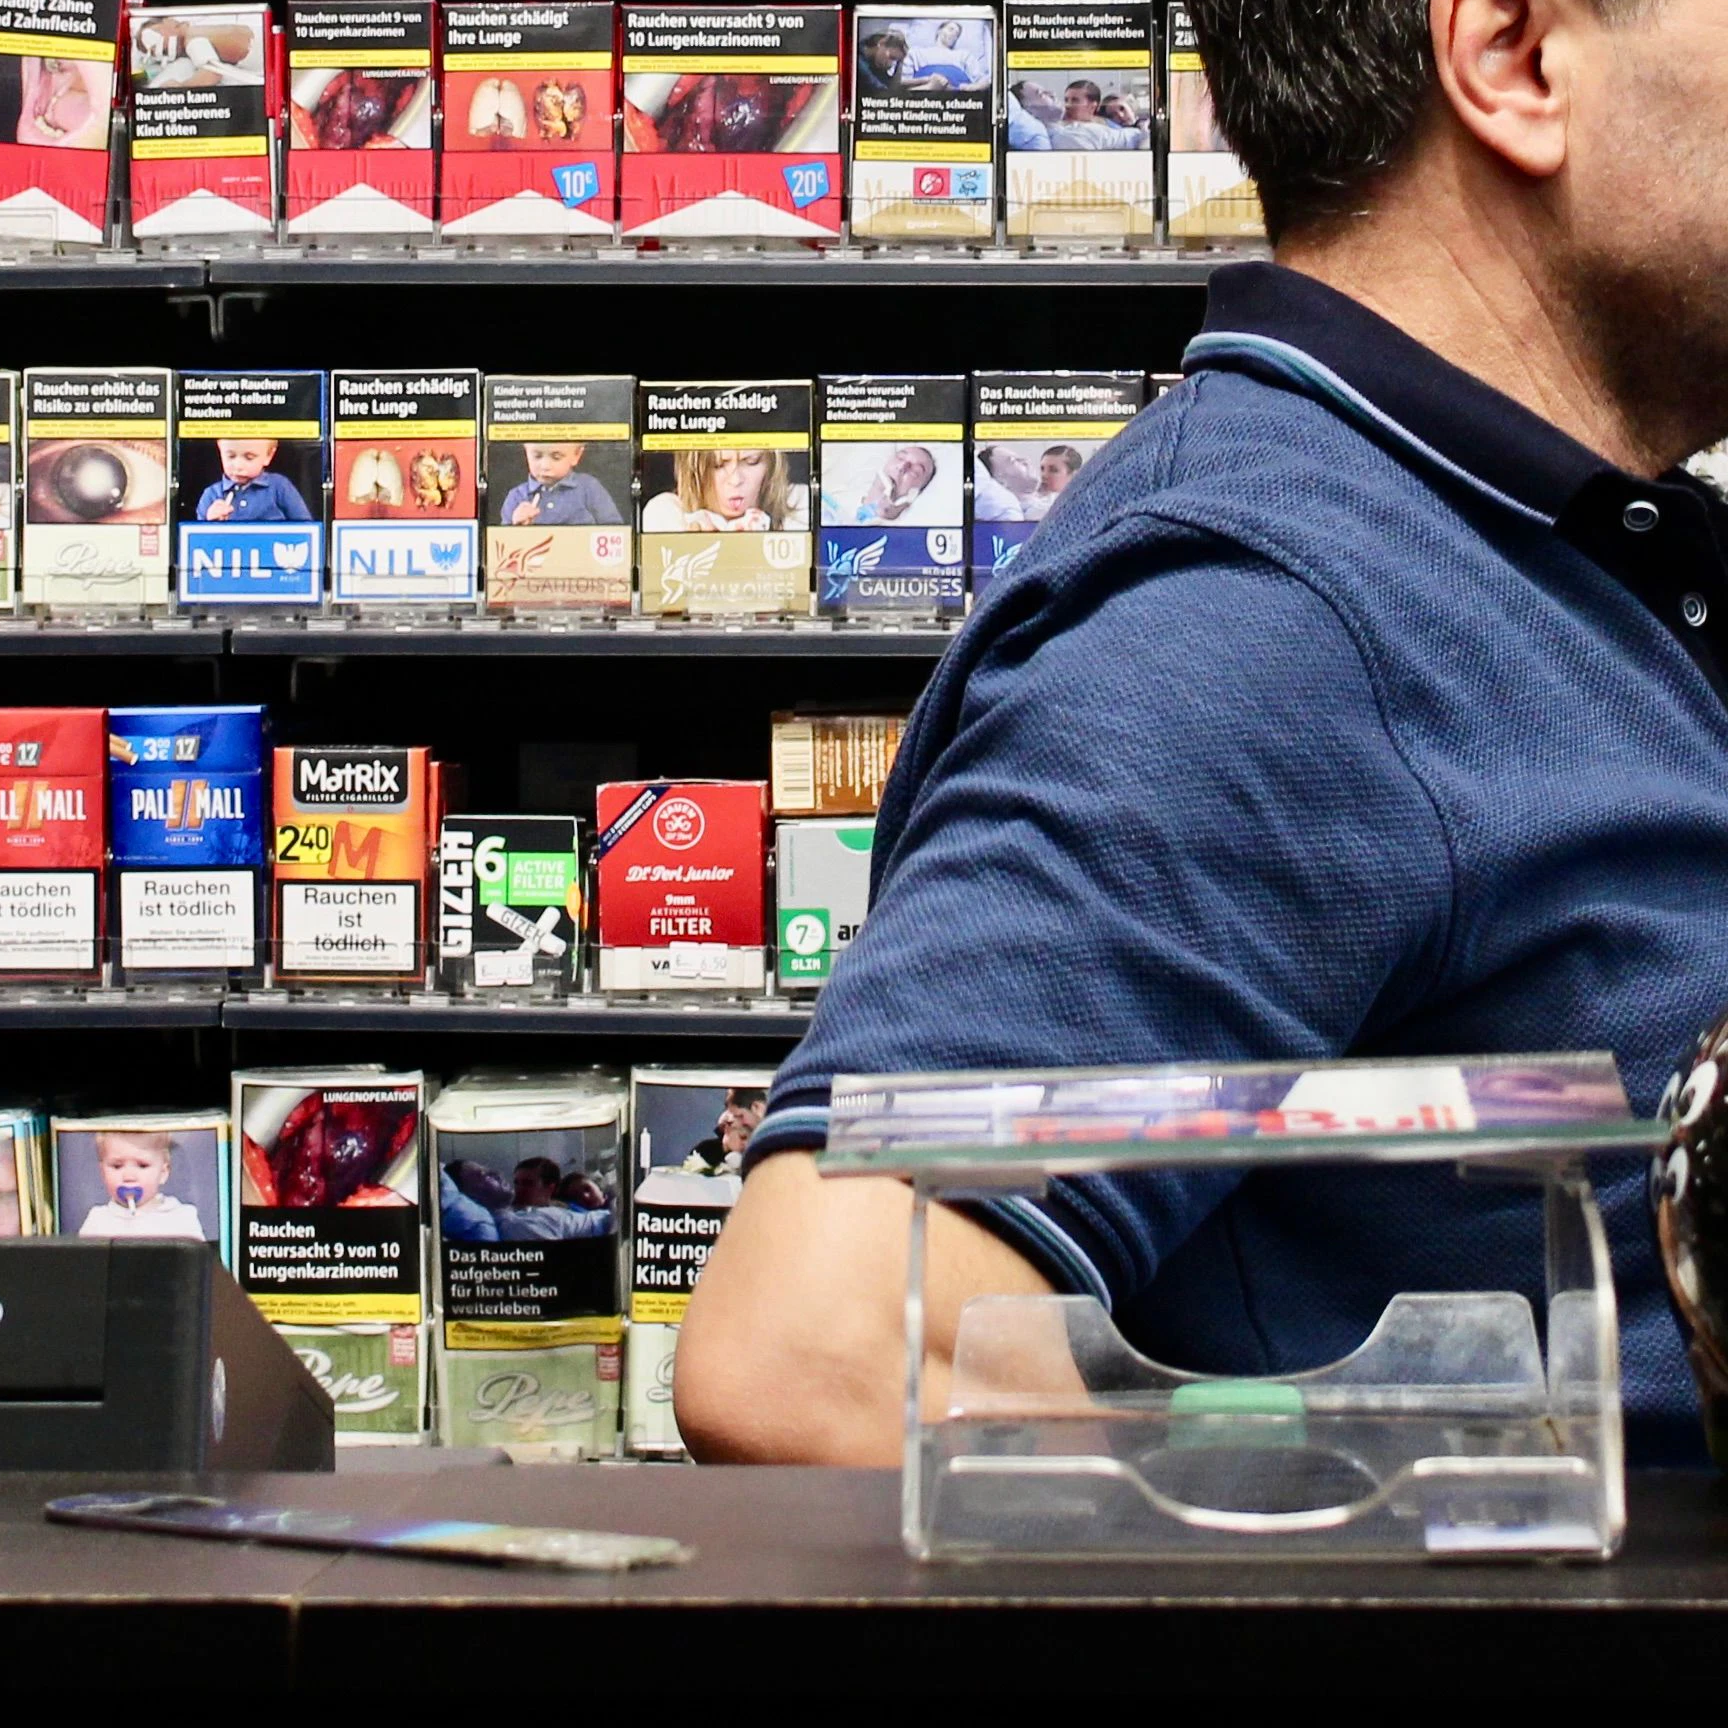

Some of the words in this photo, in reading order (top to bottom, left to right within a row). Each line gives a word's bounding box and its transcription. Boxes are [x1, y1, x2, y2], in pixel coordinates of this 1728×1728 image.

[628, 13, 686, 30] Rauchen
[691, 14, 761, 30] verursacht
[766, 14, 775, 30] 9
[779, 17, 804, 30] von
[628, 31, 645, 47] 10
[648, 31, 781, 50] Lungenkarzinomen
[350, 548, 428, 577] NIL
[858, 576, 964, 598] GAULOISES
[37, 789, 86, 820] MALL
[306, 794, 336, 802] FILTER
[340, 794, 395, 803] CIGARILLOS
[514, 859, 566, 873] ACTIVE
[513, 873, 566, 889] FILTER
[304, 888, 397, 905] Rauchen
[440, 831, 473, 957] GIZEH
[664, 894, 695, 906] 9mm
[9, 900, 76, 919] tödlich
[338, 911, 363, 927] ist
[649, 917, 712, 936] FILTER
[314, 931, 386, 952] tödlich
[323, 1092, 416, 1103] LUNGENOPERATION
[249, 1222, 315, 1239] Rauchen
[249, 1243, 331, 1260] verursacht
[334, 1243, 344, 1259] 9
[348, 1244, 377, 1259] von
[381, 1243, 400, 1259] 10
[249, 1262, 399, 1281] Lungenkarzinomen
